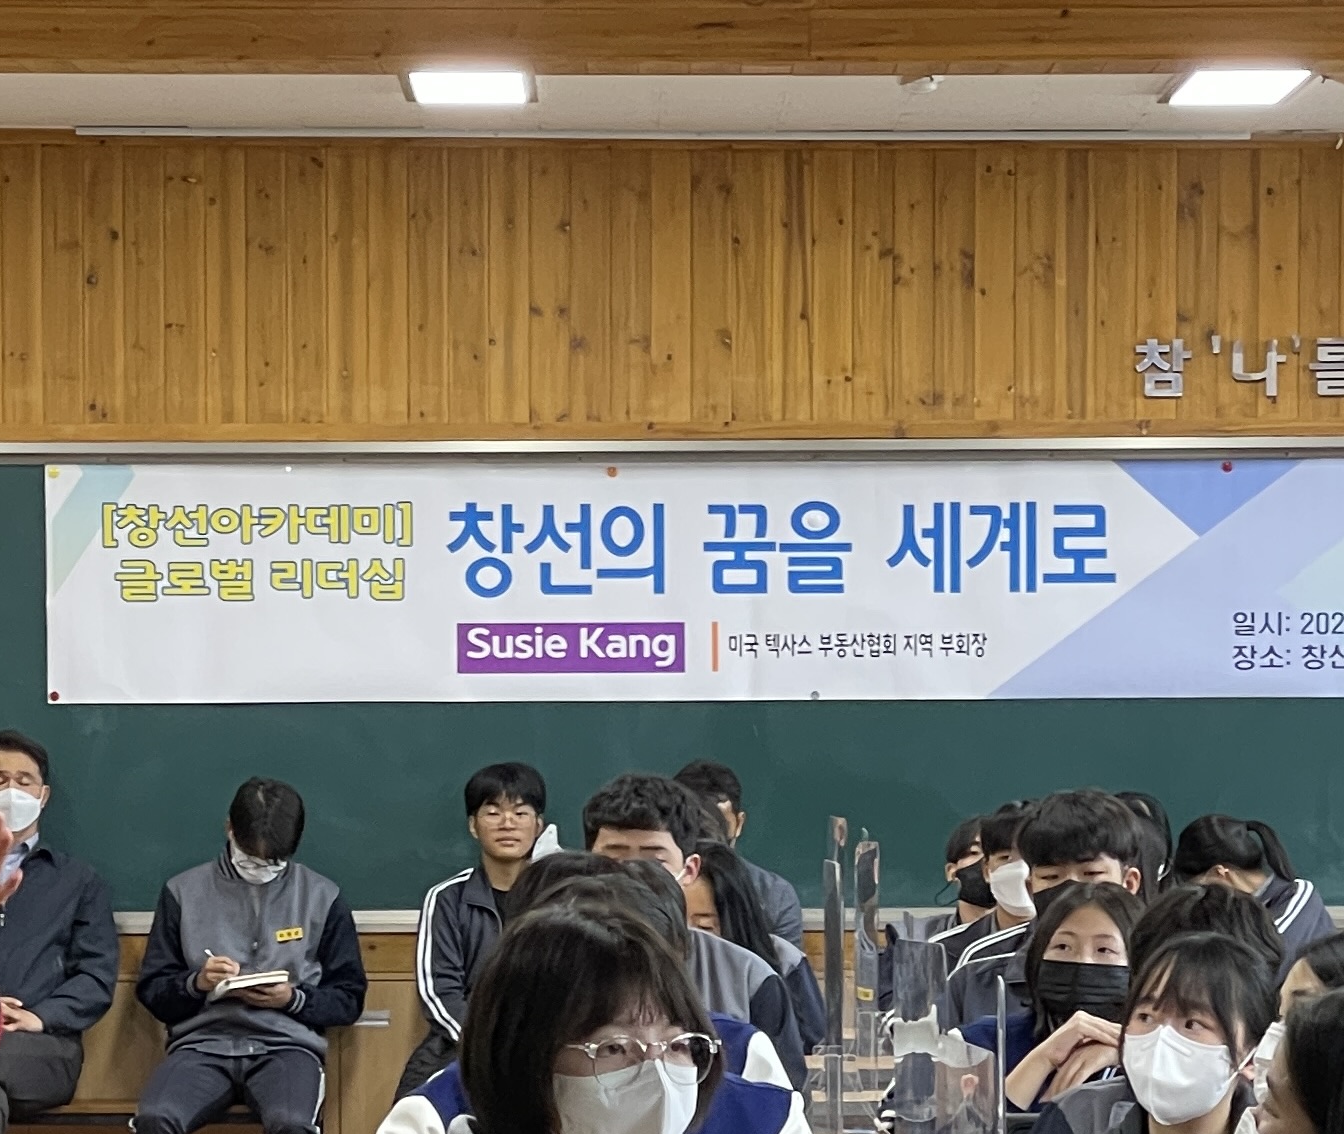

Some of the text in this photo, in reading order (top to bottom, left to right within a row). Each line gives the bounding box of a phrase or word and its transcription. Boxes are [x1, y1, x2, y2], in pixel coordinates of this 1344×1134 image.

[1136, 338, 1192, 397] 참
[102, 501, 413, 548] [창선아카데미]
[446, 501, 1116, 598] 창선의 꿈을 세계로
[115, 558, 405, 601] 글로벌 리더십
[1233, 611, 1291, 636] 일시:
[466, 627, 676, 667] Susie Kang
[728, 633, 987, 658] 미국 텍사스 부동산협회 지역 부회장
[1233, 645, 1291, 671] 장소:
